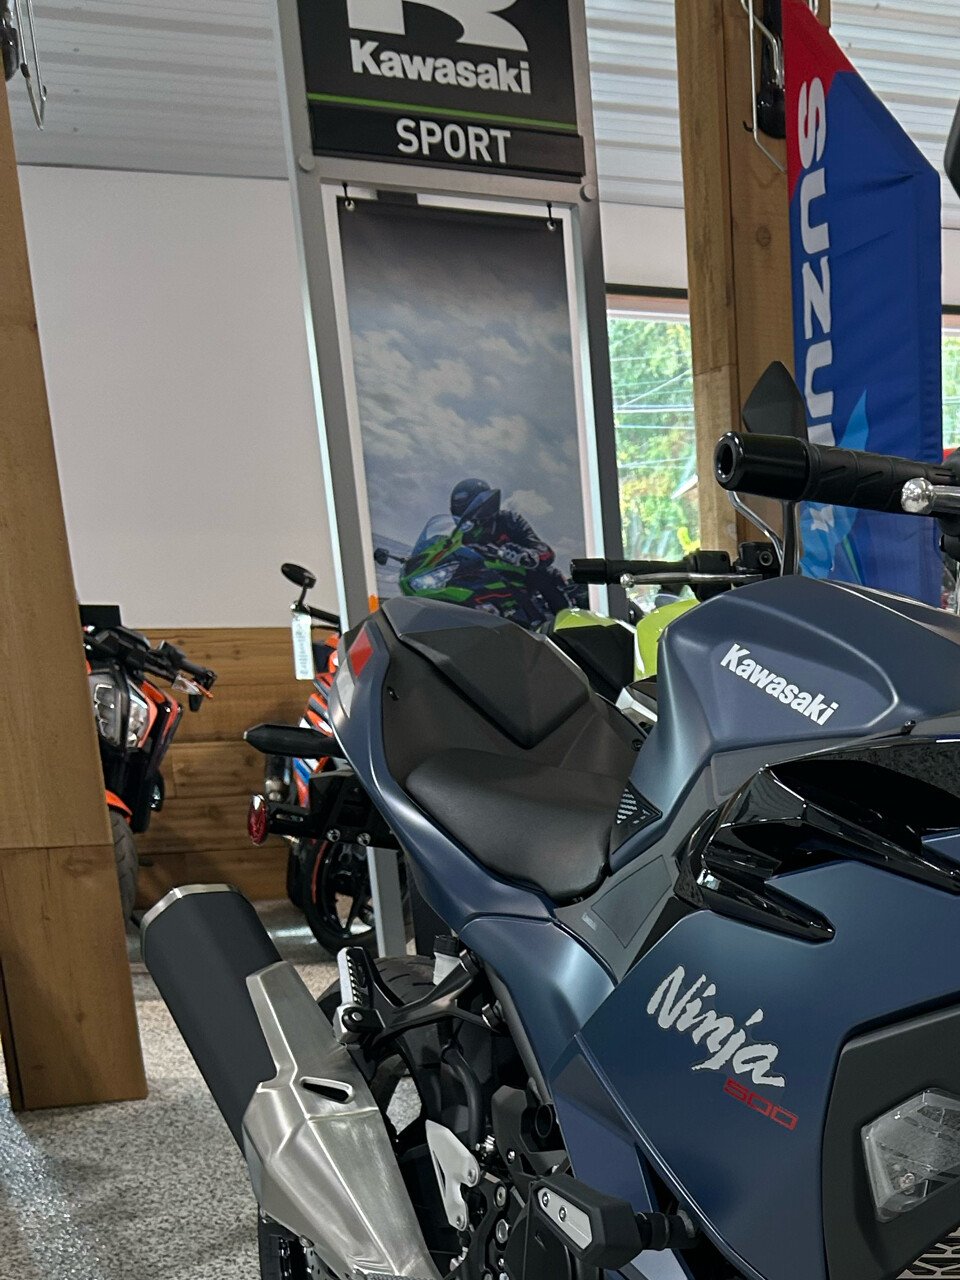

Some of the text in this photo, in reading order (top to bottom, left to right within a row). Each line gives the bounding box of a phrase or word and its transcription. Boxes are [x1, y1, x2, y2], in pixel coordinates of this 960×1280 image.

[350, 38, 531, 95] Kawasaki
[396, 118, 511, 164] SPORT
[798, 77, 836, 447] SUZU
[720, 643, 839, 726] Kawasaki
[646, 965, 786, 1088] Ninja
[722, 1076, 799, 1132] 500
